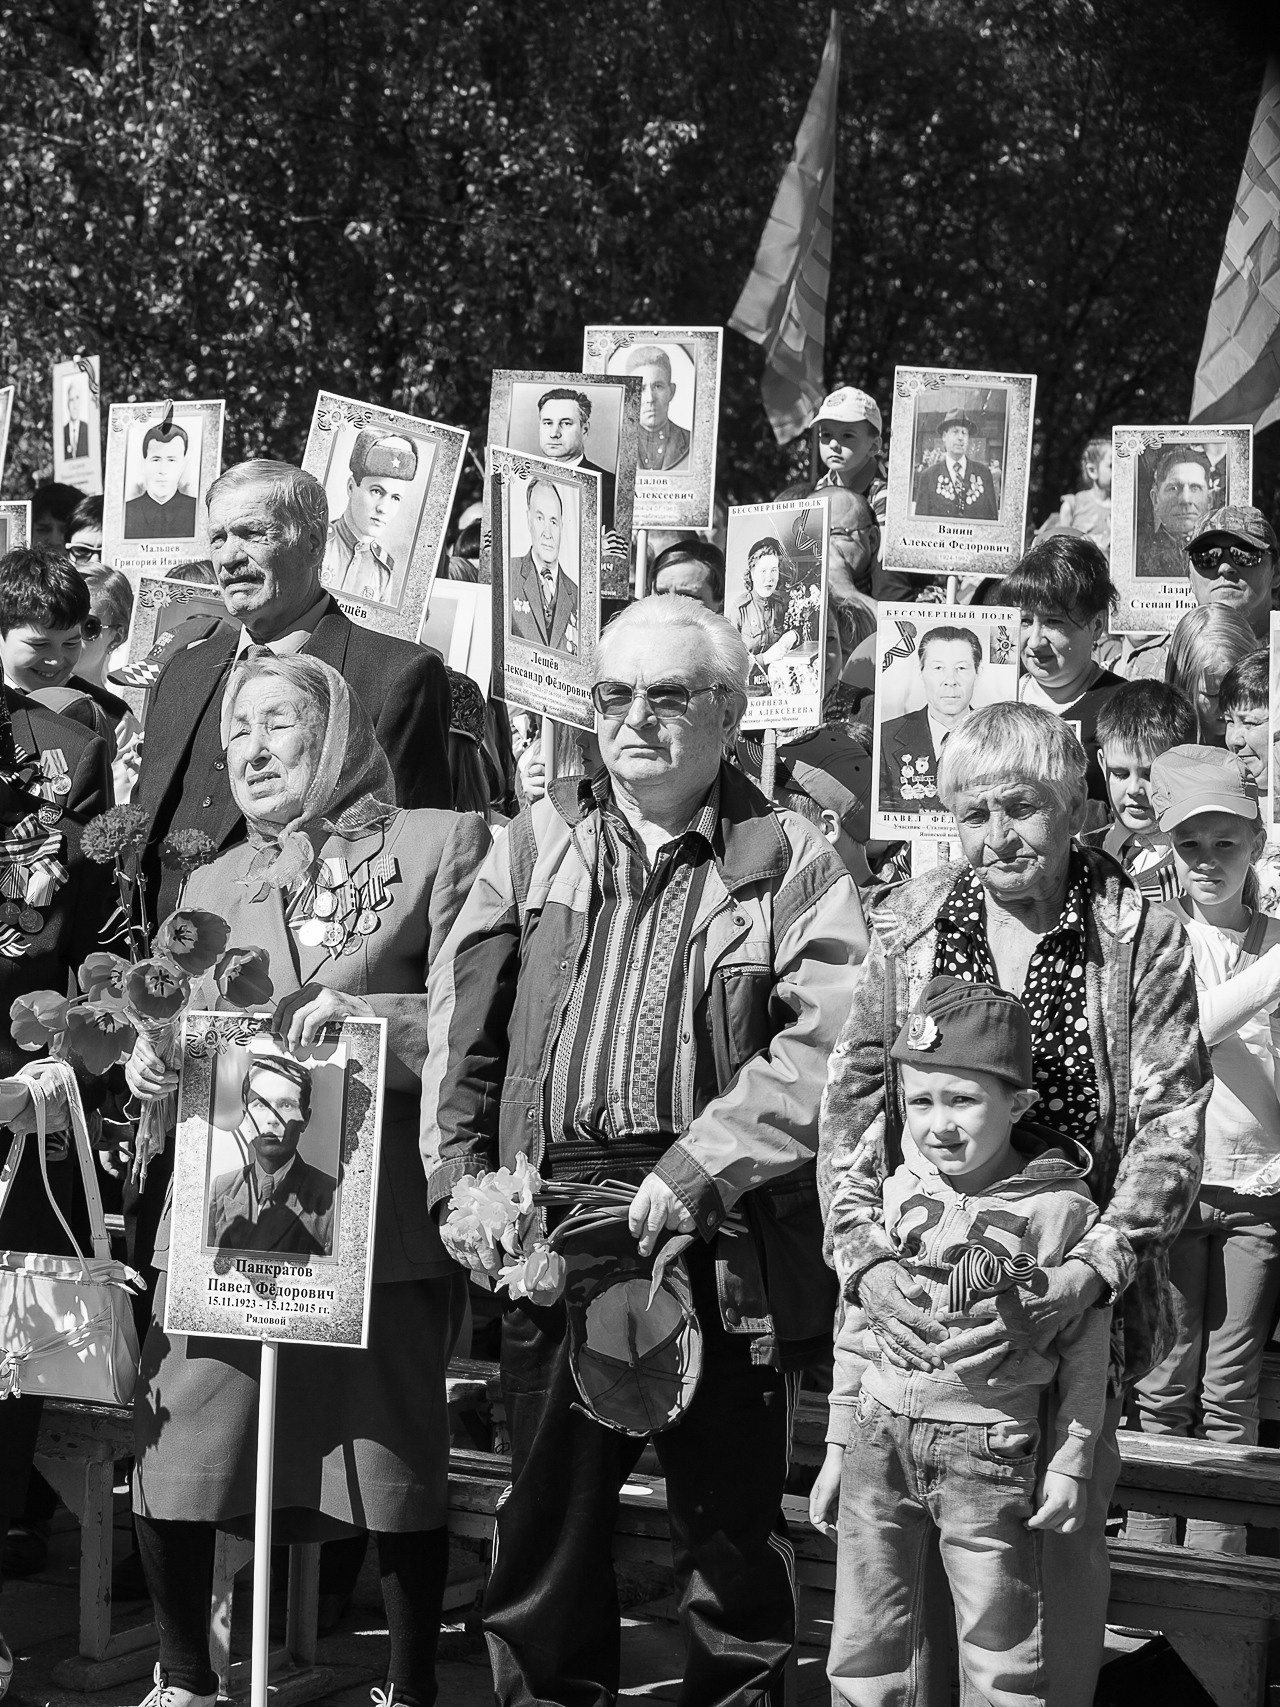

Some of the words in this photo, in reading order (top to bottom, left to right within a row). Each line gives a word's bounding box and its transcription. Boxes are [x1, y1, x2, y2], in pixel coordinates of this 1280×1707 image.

[732, 502, 795, 515] БЕССМЕРТНЫЙ
[798, 499, 822, 508] ПОЛК
[938, 524, 973, 536] Ванин
[140, 544, 180, 553] Мальцев
[899, 537, 945, 549] Алексей
[114, 558, 157, 568] Григорий
[1158, 585, 1193, 596] Лазар
[336, 599, 368, 619] ещёв
[1131, 599, 1171, 609] Степан
[1175, 600, 1197, 609] Ива
[886, 609, 975, 619] БЕССМЕРТНЫЙ
[981, 612, 1014, 620] ПОЛК
[499, 659, 543, 685] Александр
[545, 674, 592, 700] Фёдорович
[883, 814, 921, 823] ПАВЕЛ
[931, 814, 955, 824] ФЁД
[235, 1258, 313, 1279] Панкратов
[207, 1277, 252, 1295] Павел
[255, 1281, 335, 1301] Фёдорович
[207, 1296, 257, 1309] 15.11.1923
[265, 1300, 317, 1314] 15.12.2015
[245, 1313, 287, 1326] Рядовой
